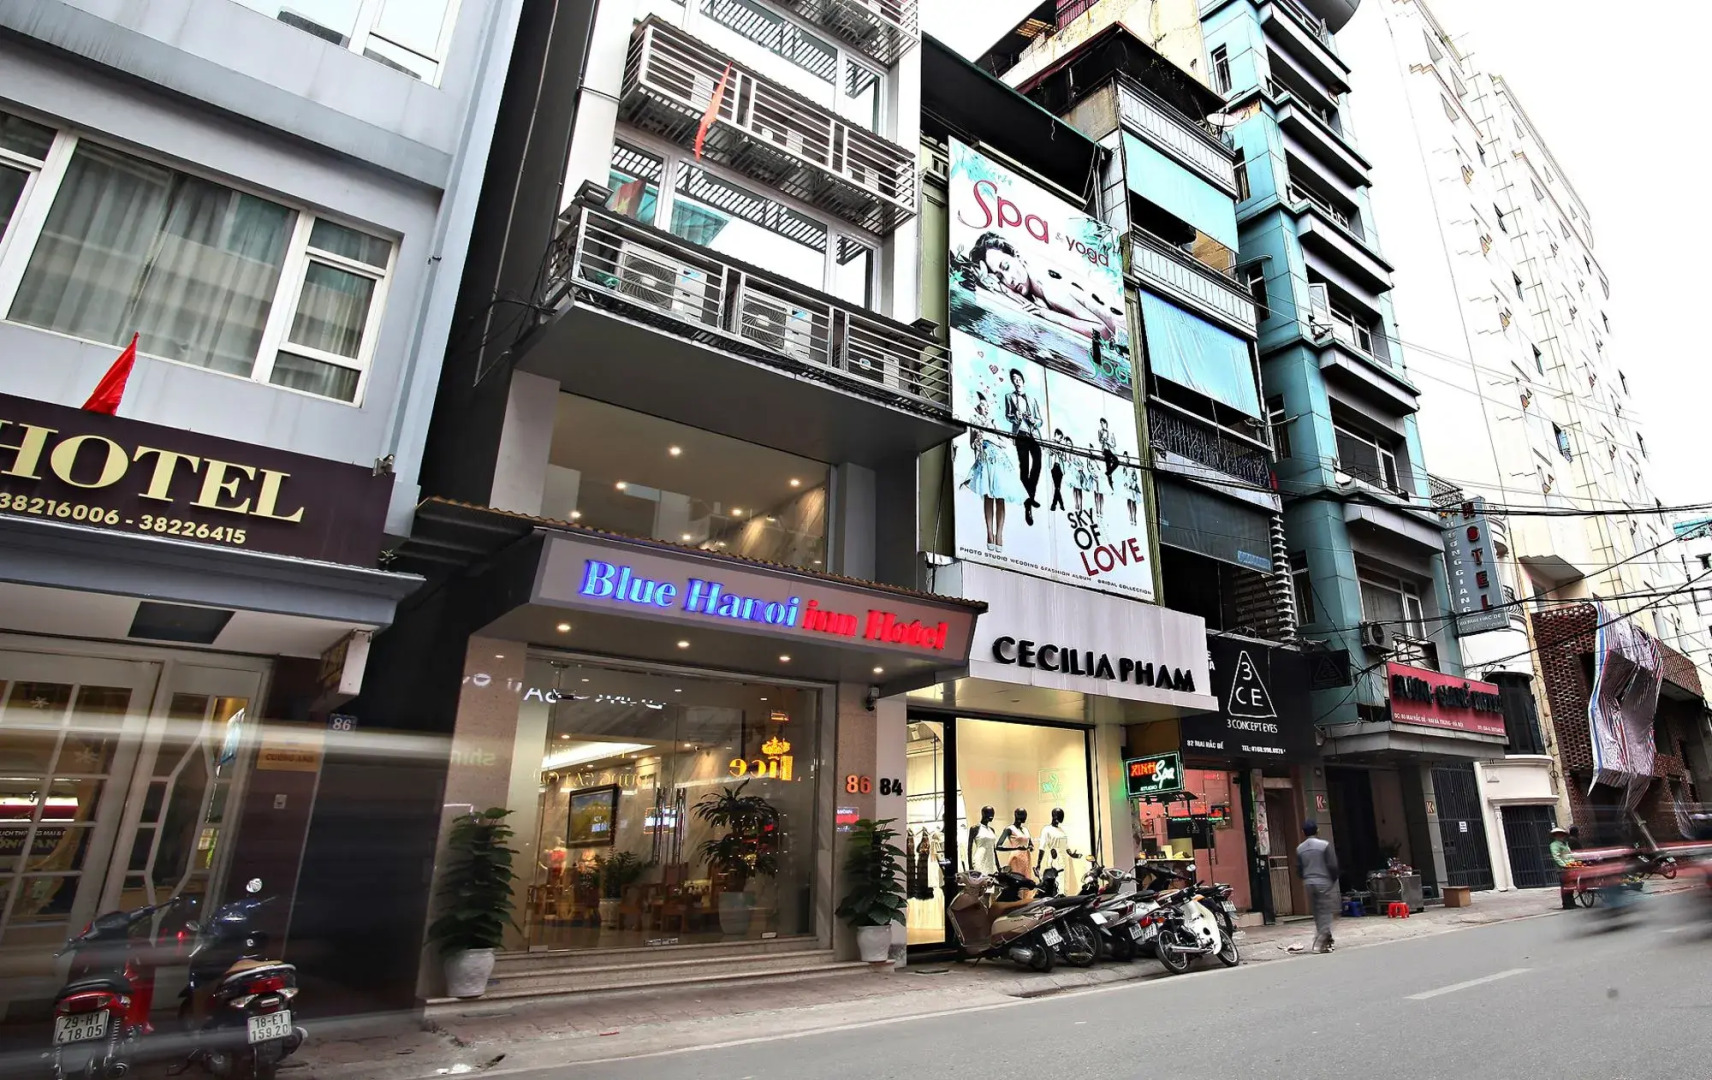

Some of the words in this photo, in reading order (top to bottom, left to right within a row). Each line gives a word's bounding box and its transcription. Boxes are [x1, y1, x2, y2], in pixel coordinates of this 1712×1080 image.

[957, 180, 1049, 244] Spa
[1065, 235, 1109, 267] yoga
[0, 420, 304, 523] HOTEL
[138, 513, 247, 545] 38226415
[1066, 507, 1094, 530] SKY
[1073, 524, 1101, 550] OF
[984, 552, 1008, 562] STUDIO
[1080, 537, 1145, 577] LOVE
[580, 558, 677, 608] Blue
[684, 577, 801, 628] Hanoi
[864, 609, 948, 651] Hotel
[991, 636, 1116, 680] CECILIA
[1119, 657, 1196, 692] PHAM
[1241, 661, 1253, 680] 3
[332, 717, 352, 731] 86
[1226, 719, 1232, 728] 3
[1232, 719, 1262, 732] CONCEPT
[1262, 723, 1278, 734] EYES
[1130, 761, 1157, 777] XINH
[846, 774, 872, 794] 86
[879, 777, 903, 796] 84
[251, 1023, 288, 1041] 159.20
[254, 1013, 284, 1029] 18-E1
